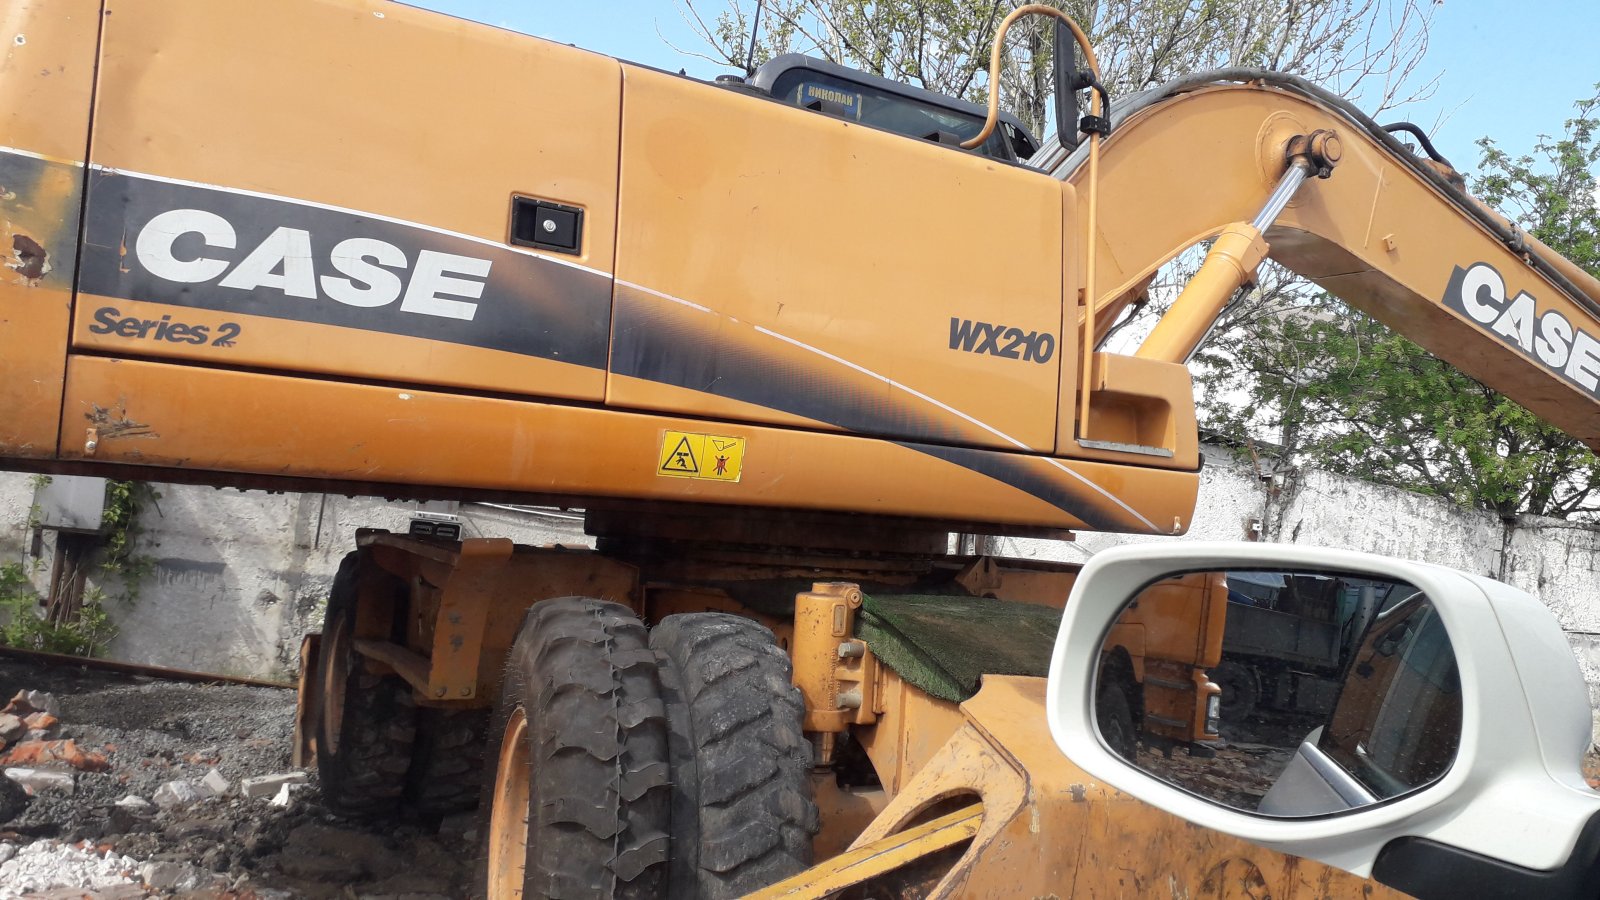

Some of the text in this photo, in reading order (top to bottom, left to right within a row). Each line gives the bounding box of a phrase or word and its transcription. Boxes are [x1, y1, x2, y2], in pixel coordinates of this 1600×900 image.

[136, 208, 493, 321] CASE
[89, 307, 241, 348] Series 2
[949, 317, 1055, 364] WX210
[1461, 265, 1600, 392] CASE
